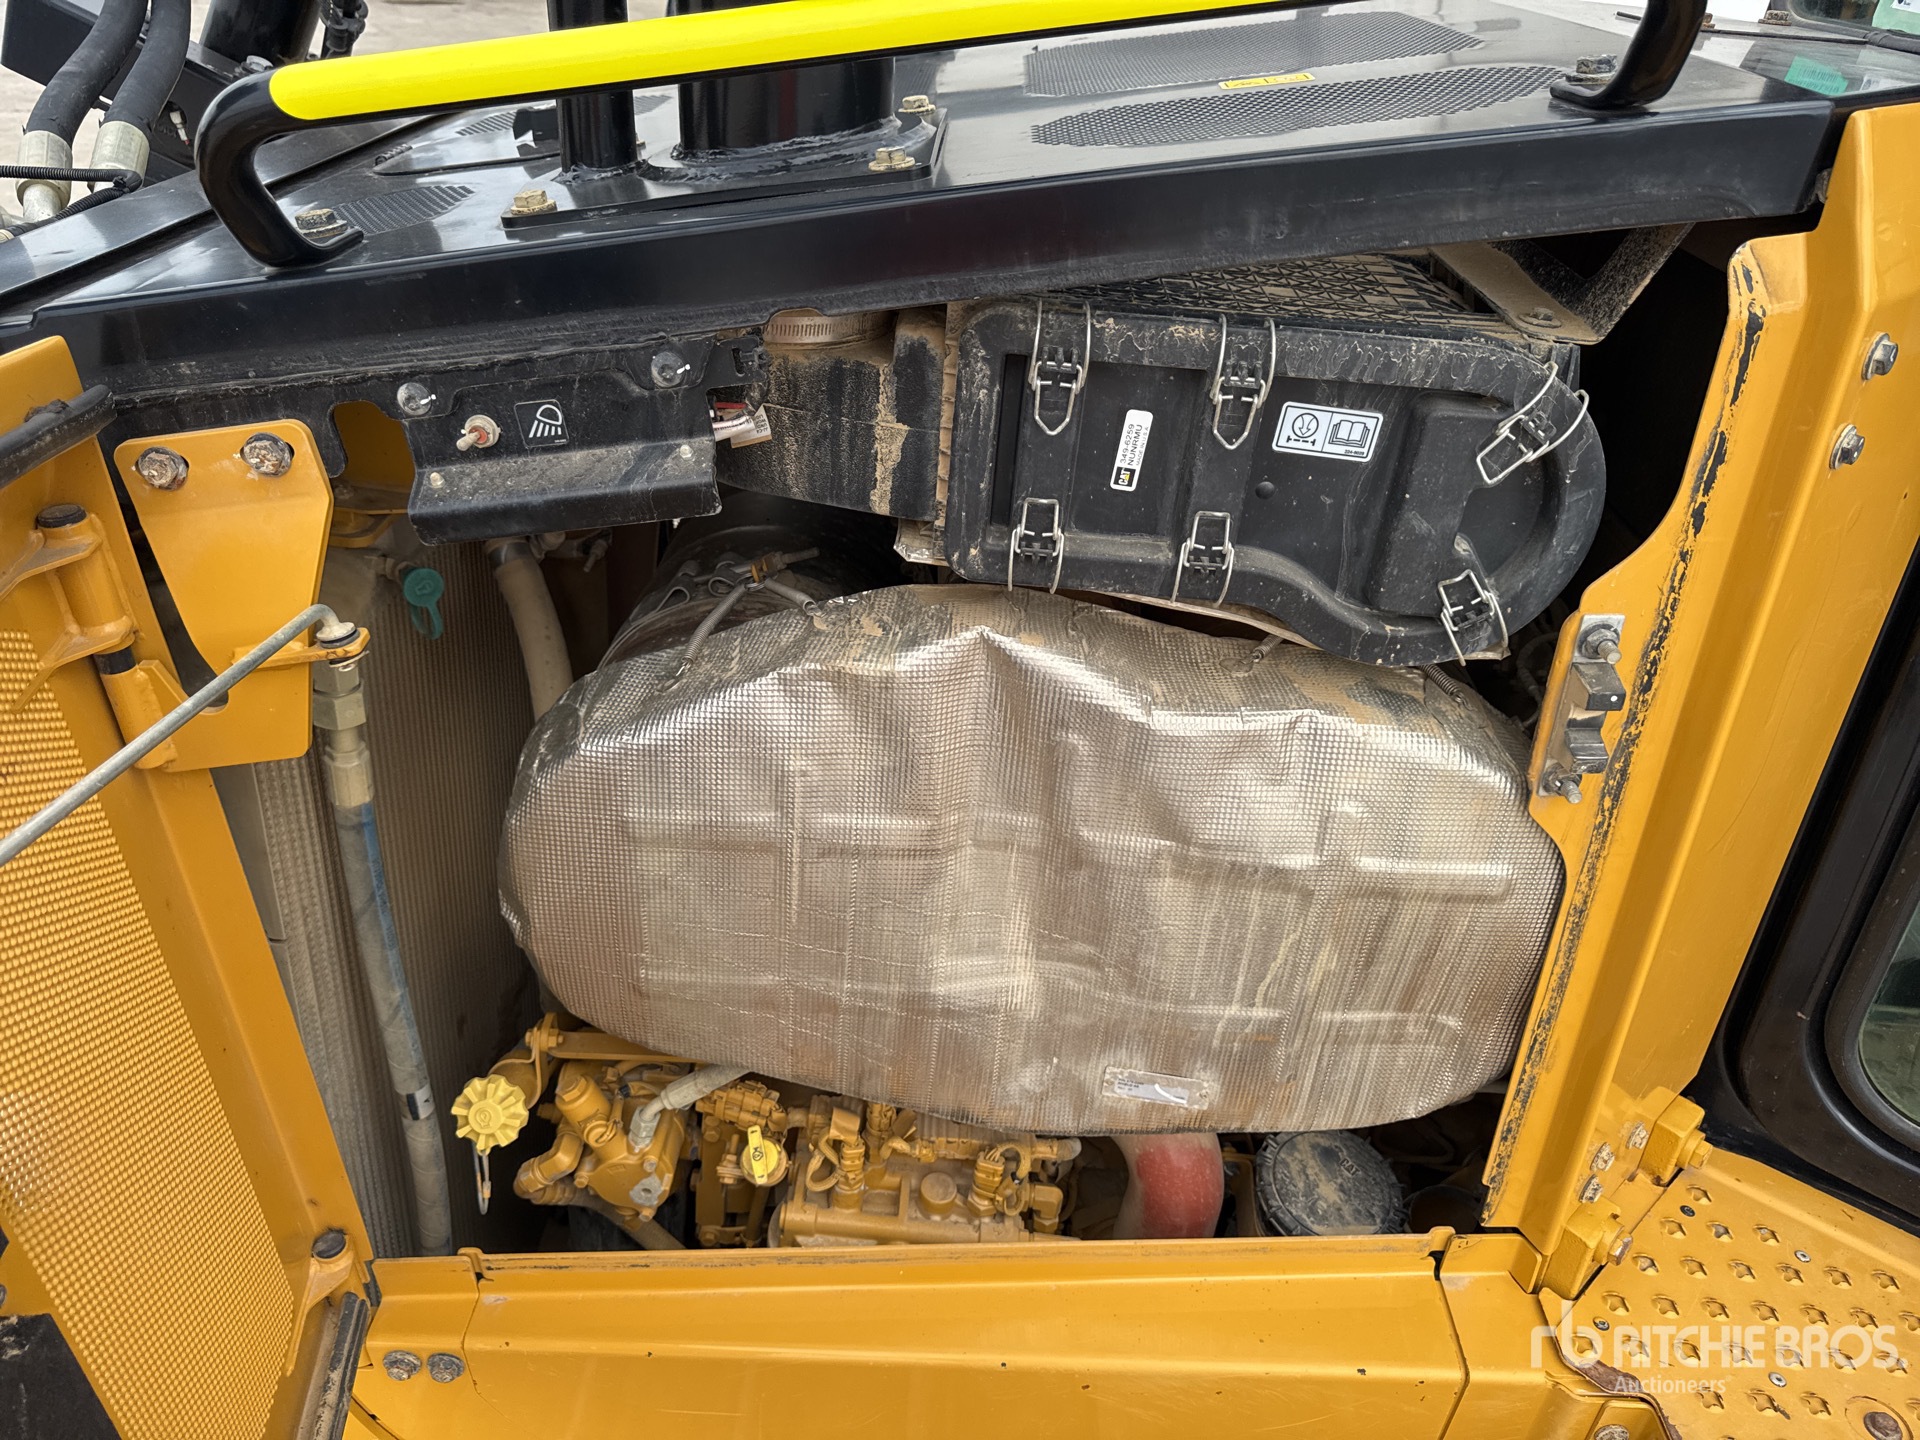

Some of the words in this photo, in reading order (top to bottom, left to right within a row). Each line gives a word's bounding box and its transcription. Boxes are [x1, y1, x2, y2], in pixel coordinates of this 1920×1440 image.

[1120, 423, 1135, 464] 349-6259
[1127, 424, 1143, 466] NUNRMU
[1118, 467, 1131, 486] CAT
[1340, 1158, 1360, 1176] CAT
